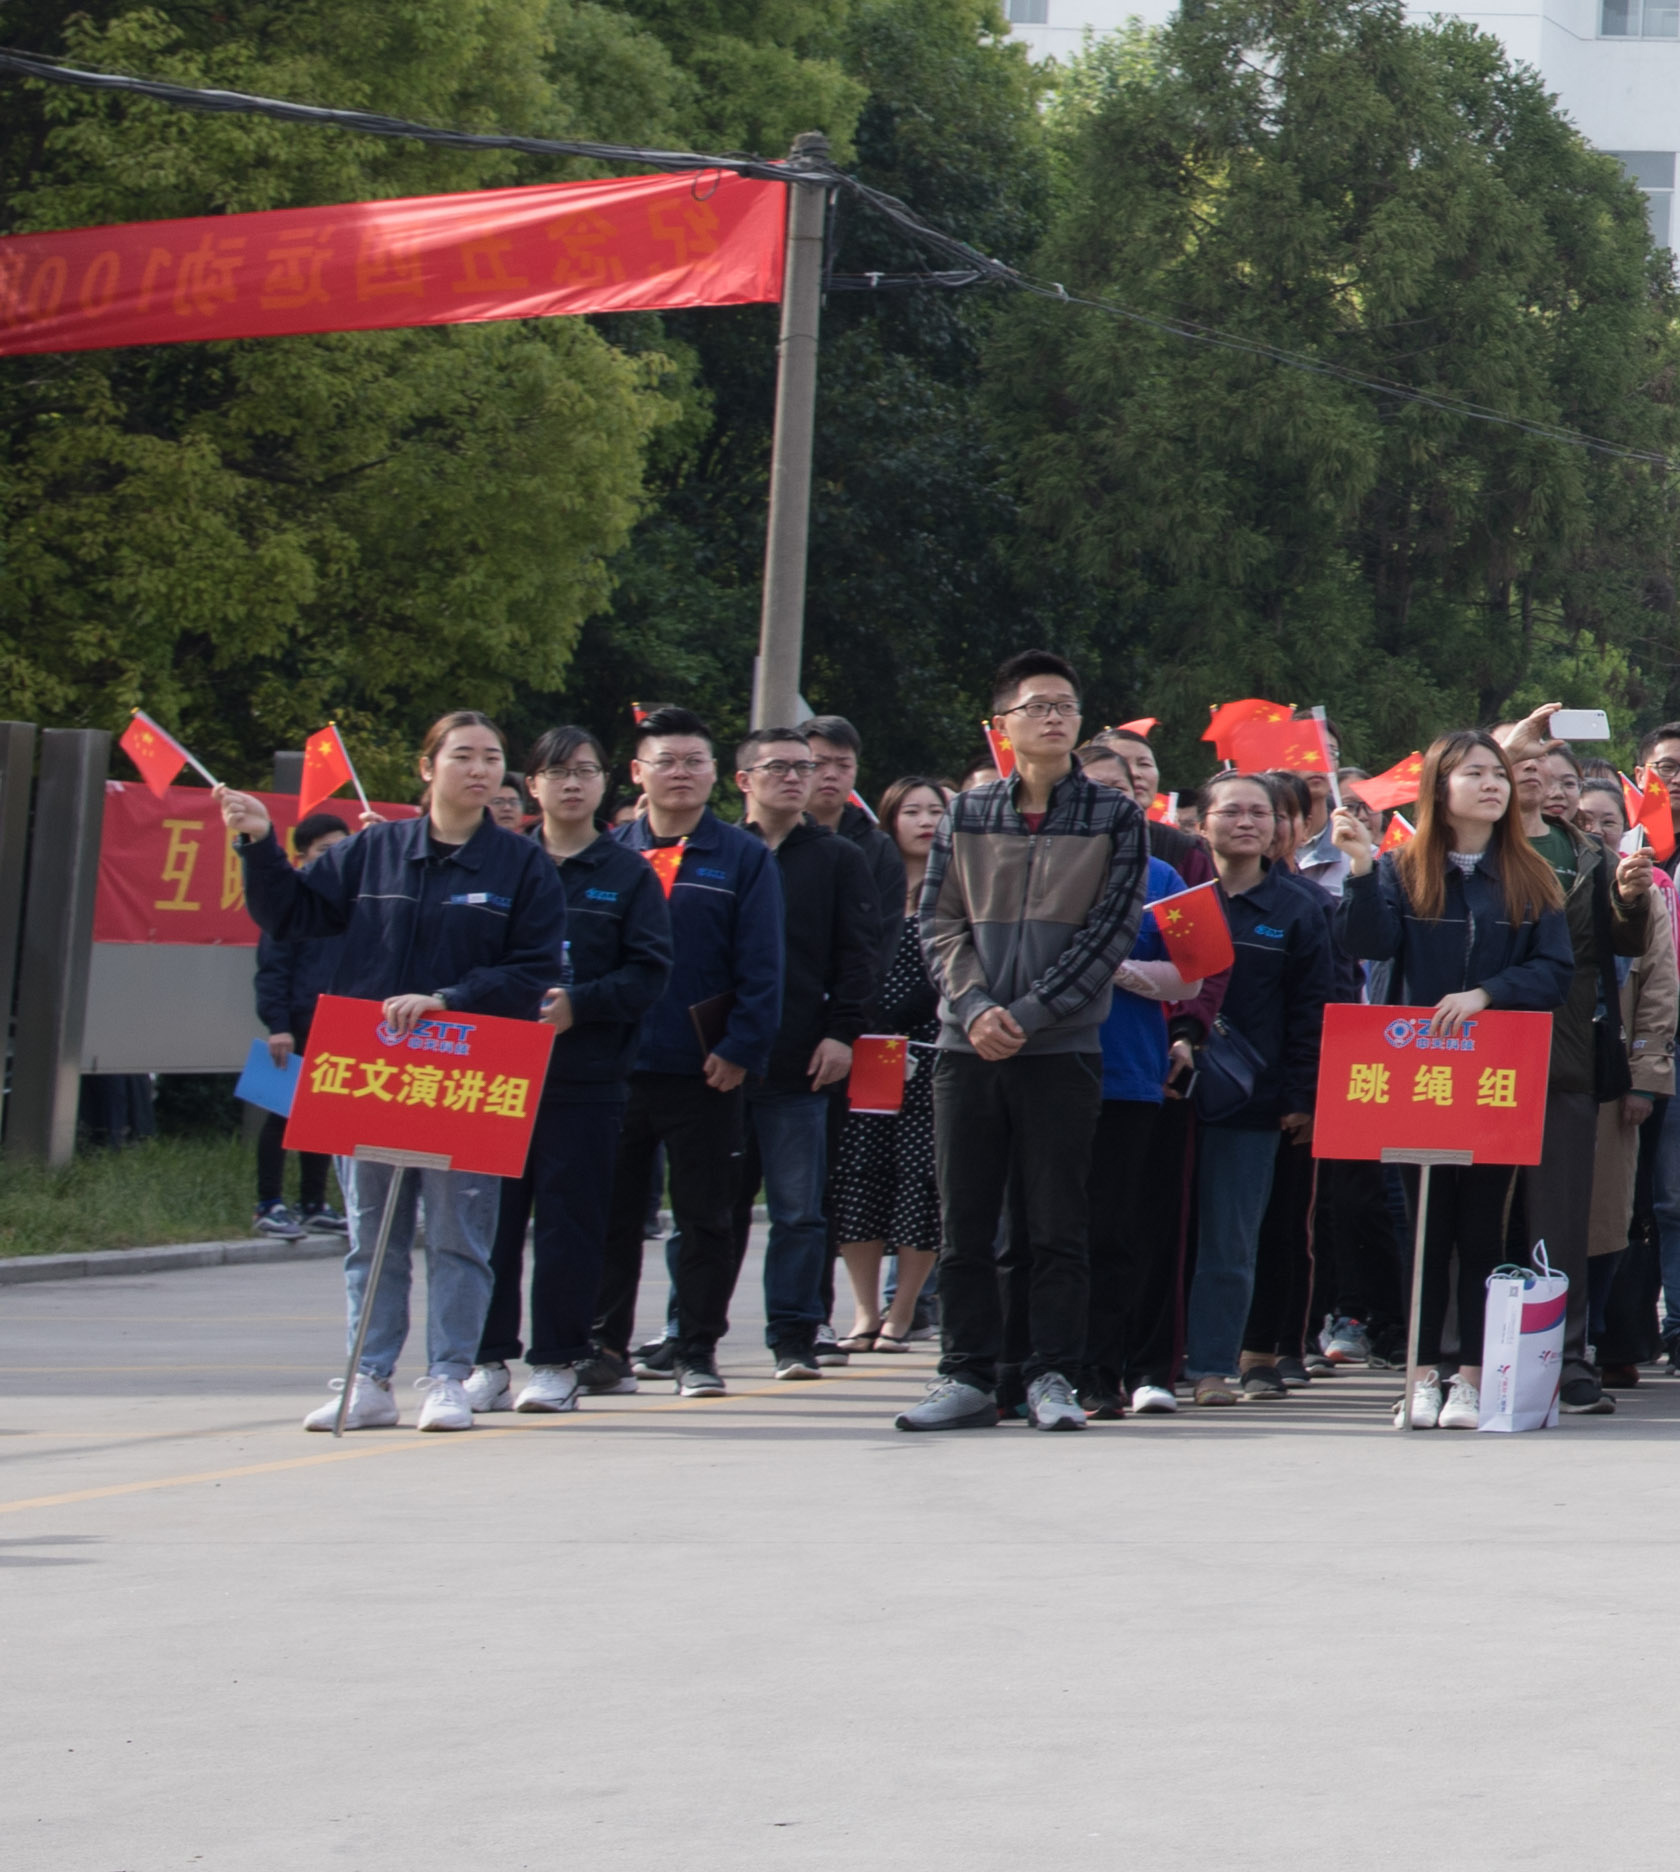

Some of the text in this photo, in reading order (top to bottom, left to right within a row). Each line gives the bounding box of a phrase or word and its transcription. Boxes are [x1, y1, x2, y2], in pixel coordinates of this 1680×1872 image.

[411, 1019, 477, 1042] ZTT
[310, 1052, 531, 1118] 征文演讲组
[1346, 1063, 1518, 1108] 跳绳组
